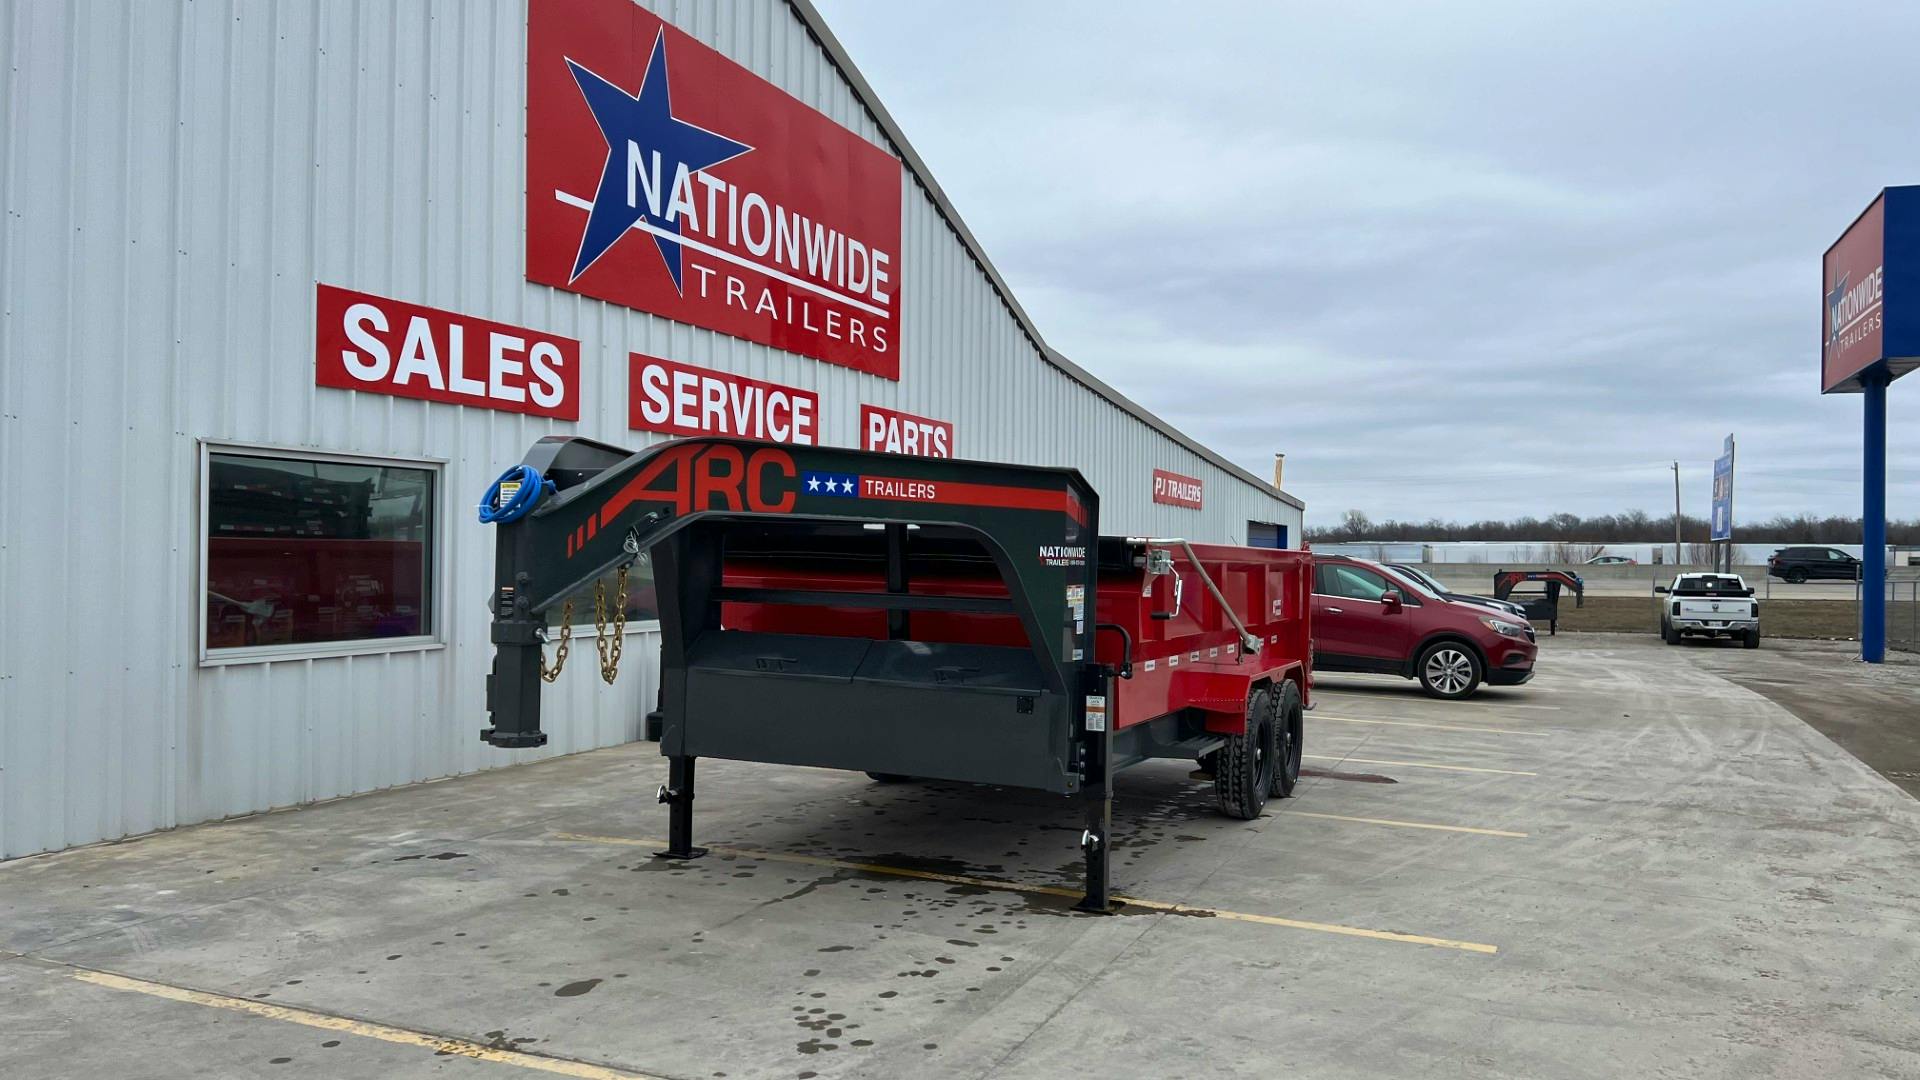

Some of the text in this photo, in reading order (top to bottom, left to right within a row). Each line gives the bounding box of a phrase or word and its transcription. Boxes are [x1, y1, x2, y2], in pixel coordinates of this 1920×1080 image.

[627, 139, 890, 304] NATIONWIDE
[691, 263, 888, 353] TRAILERS
[1831, 265, 1882, 334] NATIONWIDE
[1840, 312, 1881, 353] TRAILERS
[341, 303, 565, 408] SALES
[640, 364, 813, 445] SERVICE
[869, 412, 947, 459] PARTS
[600, 443, 796, 528] ARC
[865, 479, 936, 499] TRAILERS
[1155, 477, 1201, 502] PJ TRAILERS
[1039, 545, 1086, 558] NATIONWIDE
